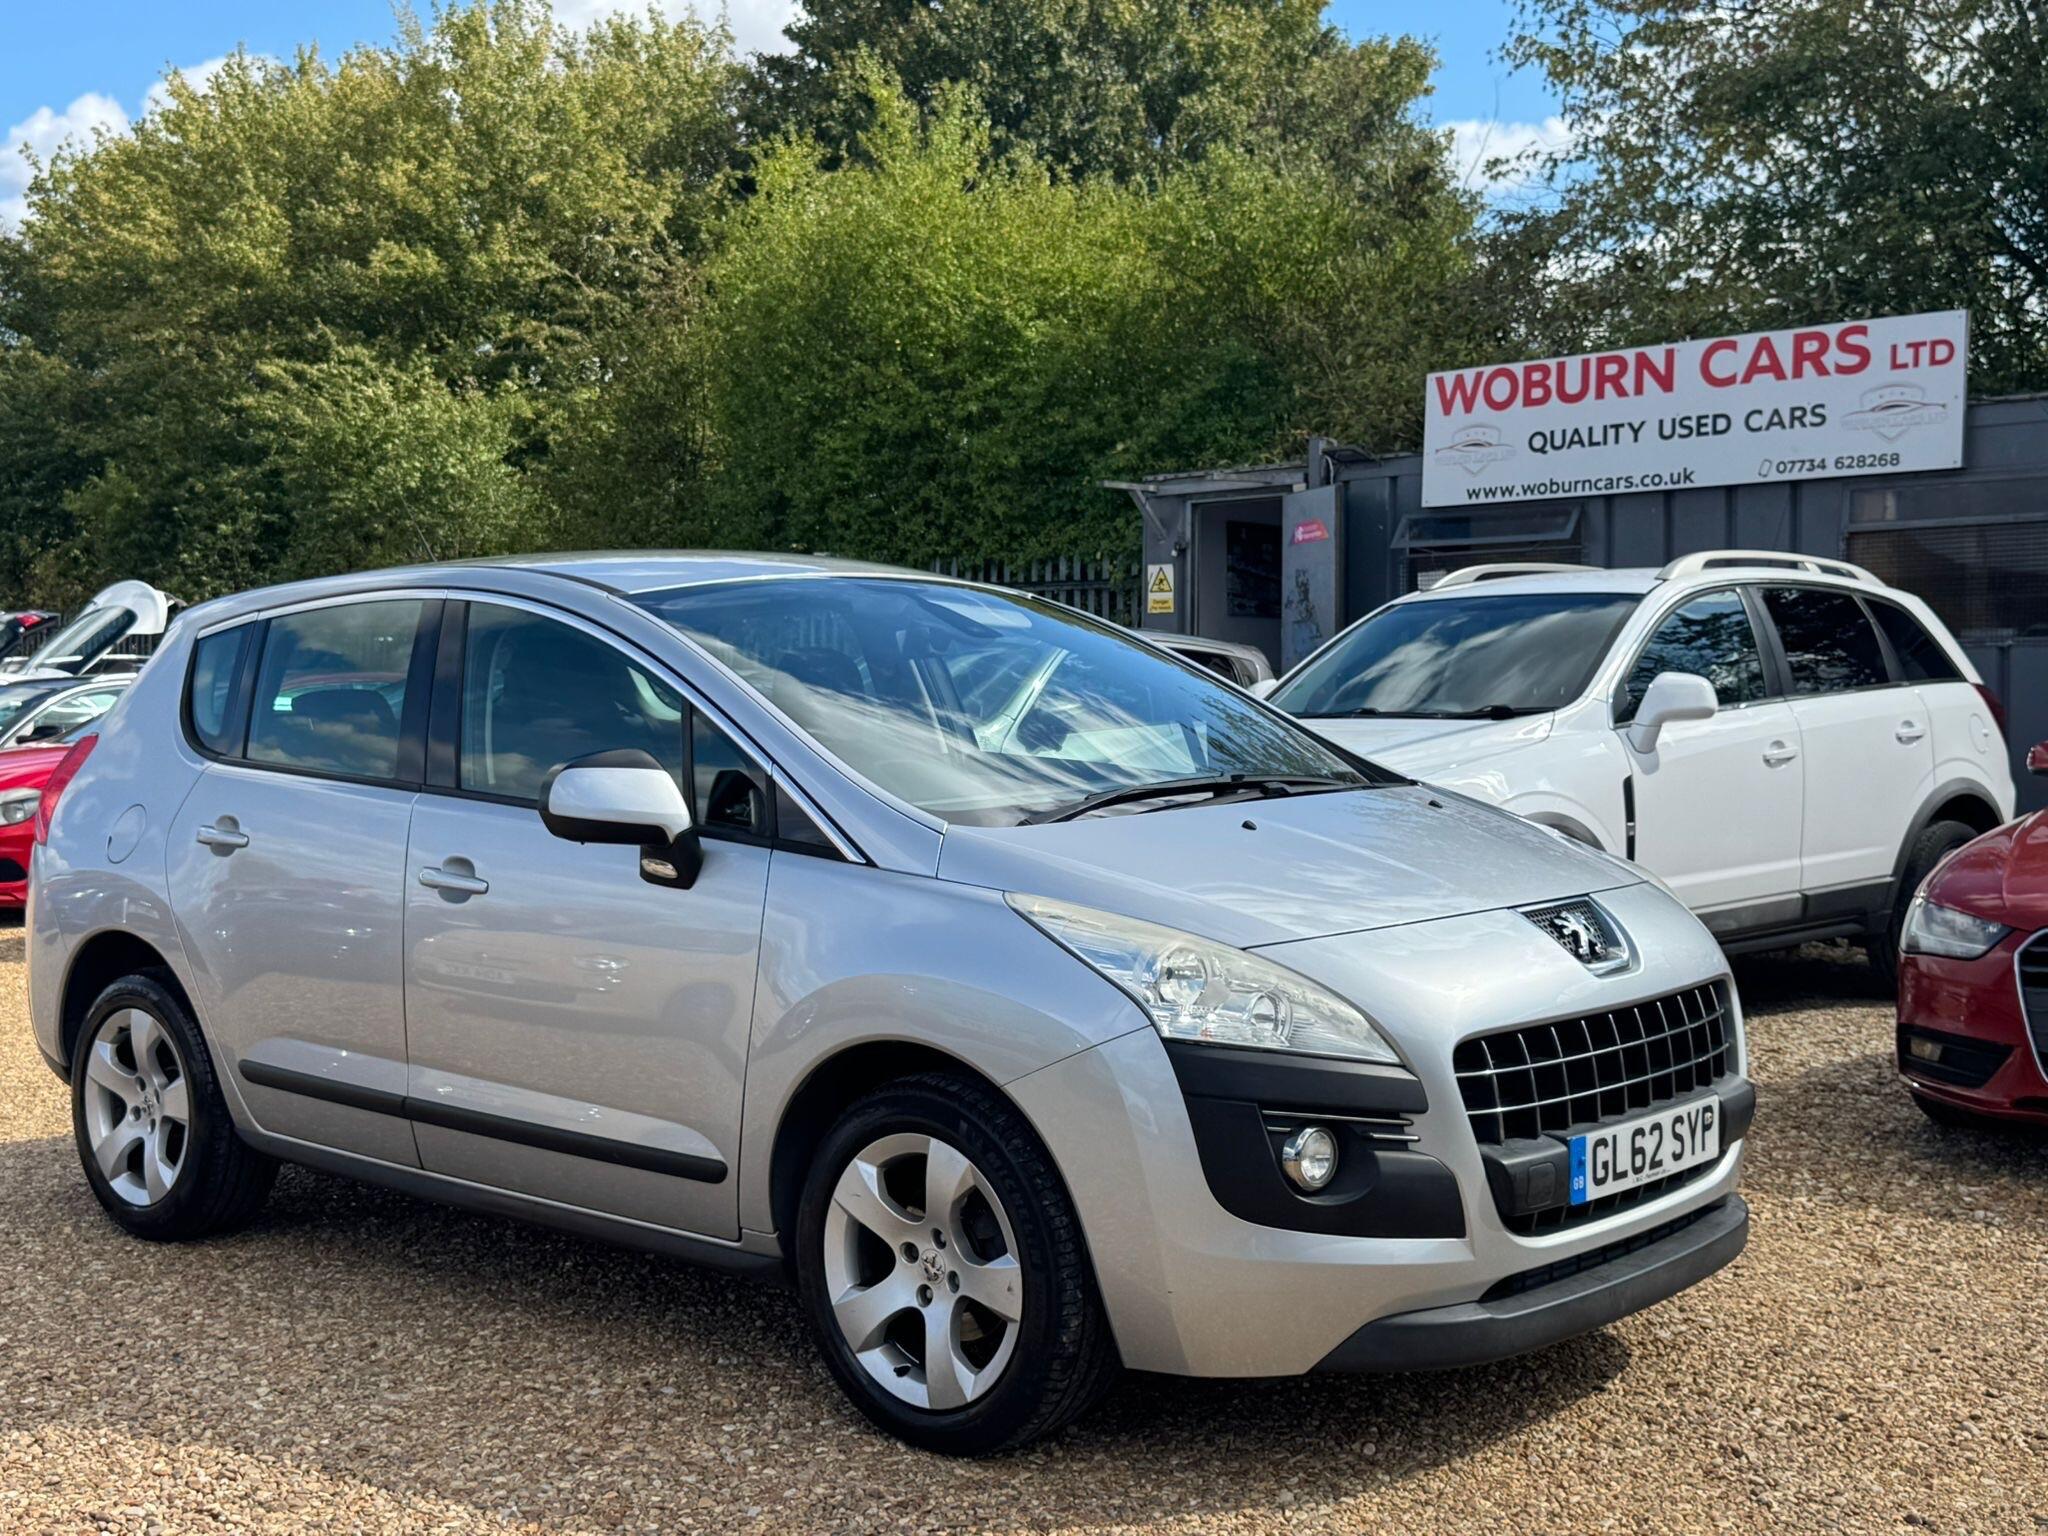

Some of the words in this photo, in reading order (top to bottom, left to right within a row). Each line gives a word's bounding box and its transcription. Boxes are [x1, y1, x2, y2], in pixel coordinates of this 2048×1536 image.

[1435, 348, 1676, 416] WOBURN
[1699, 324, 1872, 389] CARS
[1890, 339, 1955, 371] LTD
[1527, 420, 1647, 455] QUALITY
[1658, 413, 1732, 441] USED
[1744, 403, 1827, 433] CARS
[1466, 467, 1696, 500] www.woburncars.co.uk
[1775, 458, 1827, 475] 07734
[1834, 452, 1901, 470] 628268
[1591, 1121, 1664, 1187] GL62
[1671, 1104, 1714, 1162] SYP
[1573, 1175, 1585, 1190] GB
